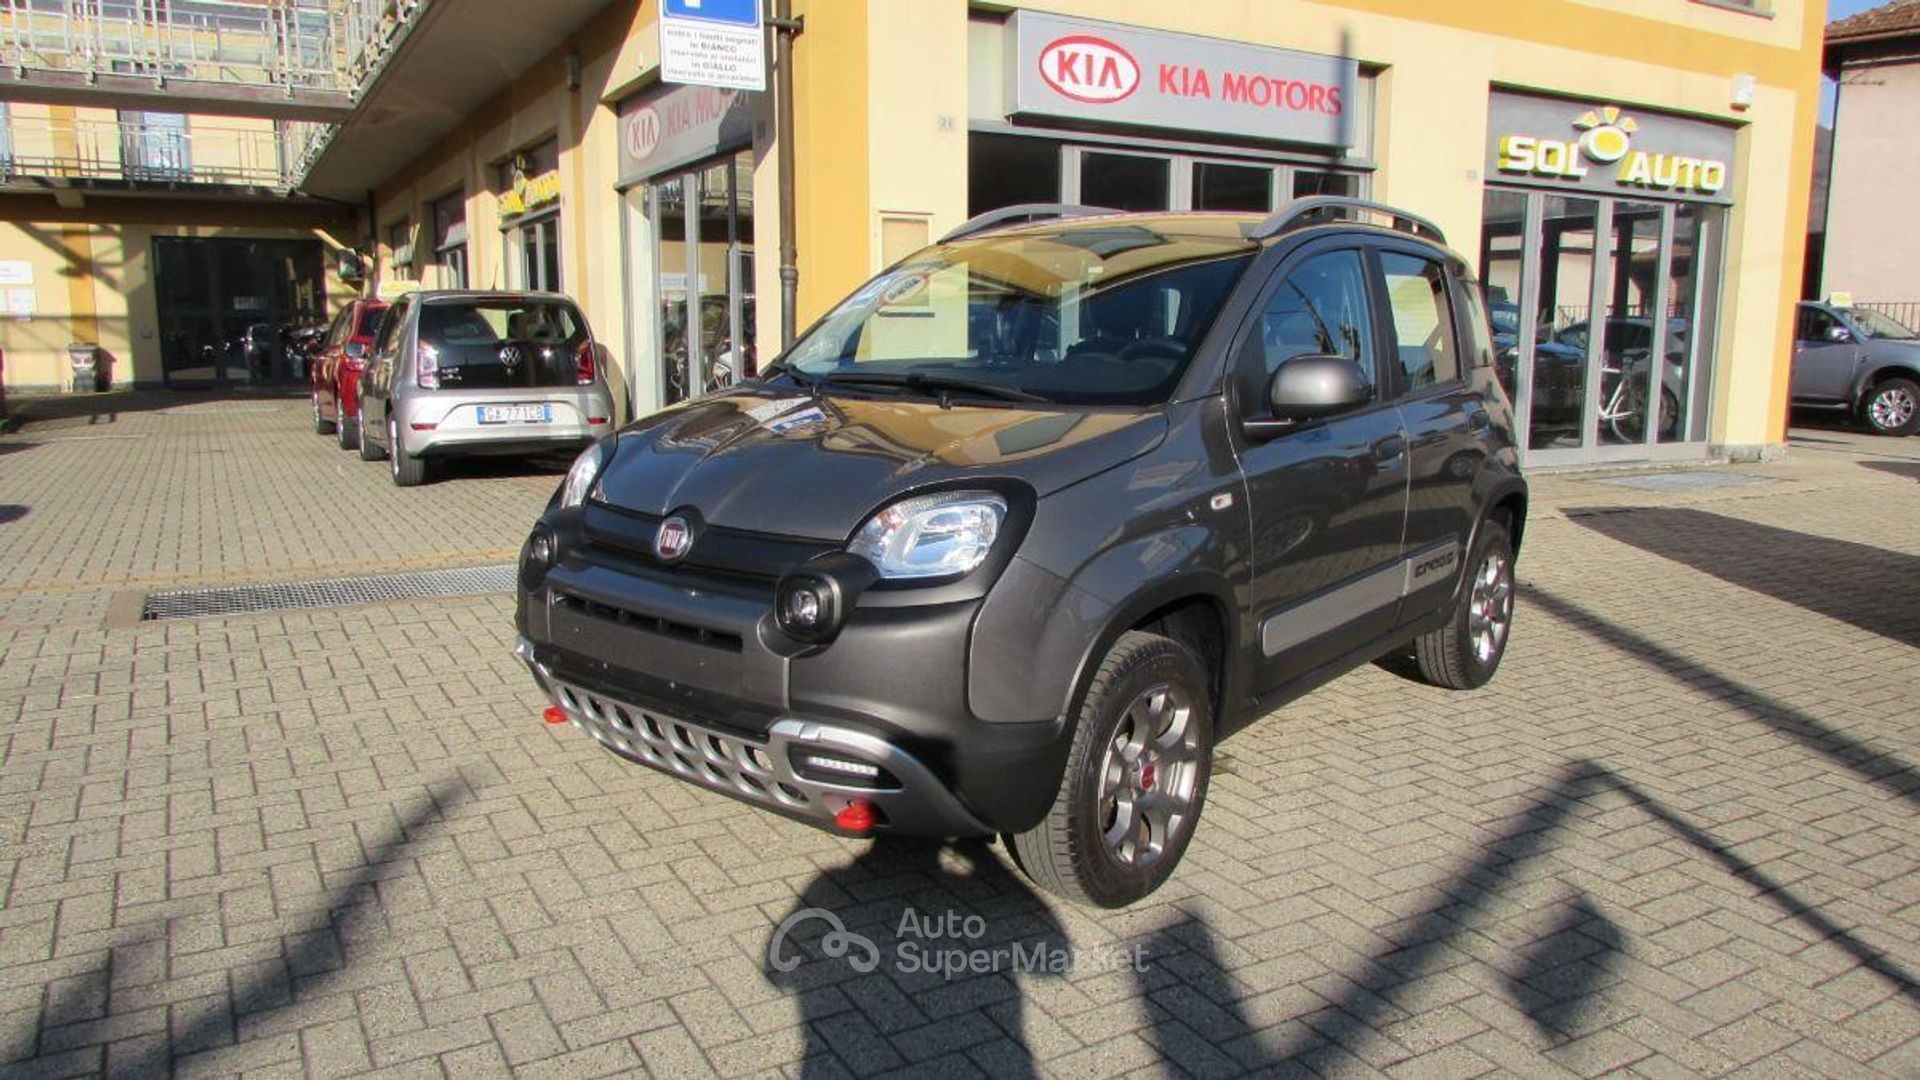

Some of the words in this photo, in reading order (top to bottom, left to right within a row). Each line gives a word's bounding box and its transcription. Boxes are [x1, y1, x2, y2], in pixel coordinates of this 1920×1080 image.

[700, 41, 738, 54] BIANCO
[1057, 50, 1123, 89] KIA
[1158, 62, 1212, 99] KIA
[1221, 71, 1343, 117] MOTORS
[1497, 135, 1589, 183] SOL
[1617, 150, 1727, 193] AUTO
[661, 529, 685, 550] FIAT
